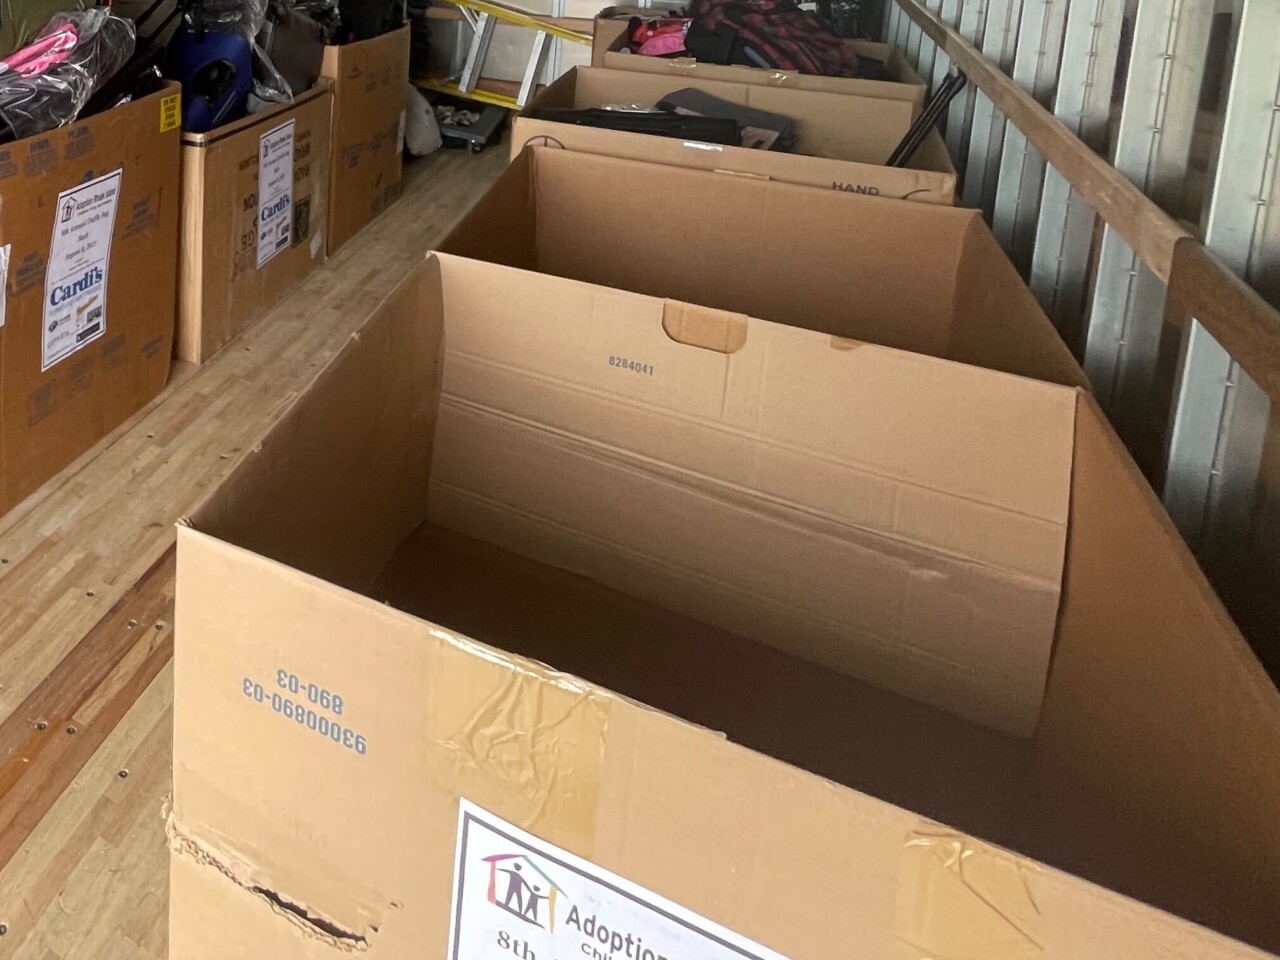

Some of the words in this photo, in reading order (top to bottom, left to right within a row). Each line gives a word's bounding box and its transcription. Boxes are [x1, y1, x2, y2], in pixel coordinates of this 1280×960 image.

[832, 181, 879, 196] HAND
[50, 266, 102, 306] Cardi's
[277, 669, 344, 715] 890-03
[242, 678, 367, 755] 93000890-03
[497, 931, 535, 960] 8th
